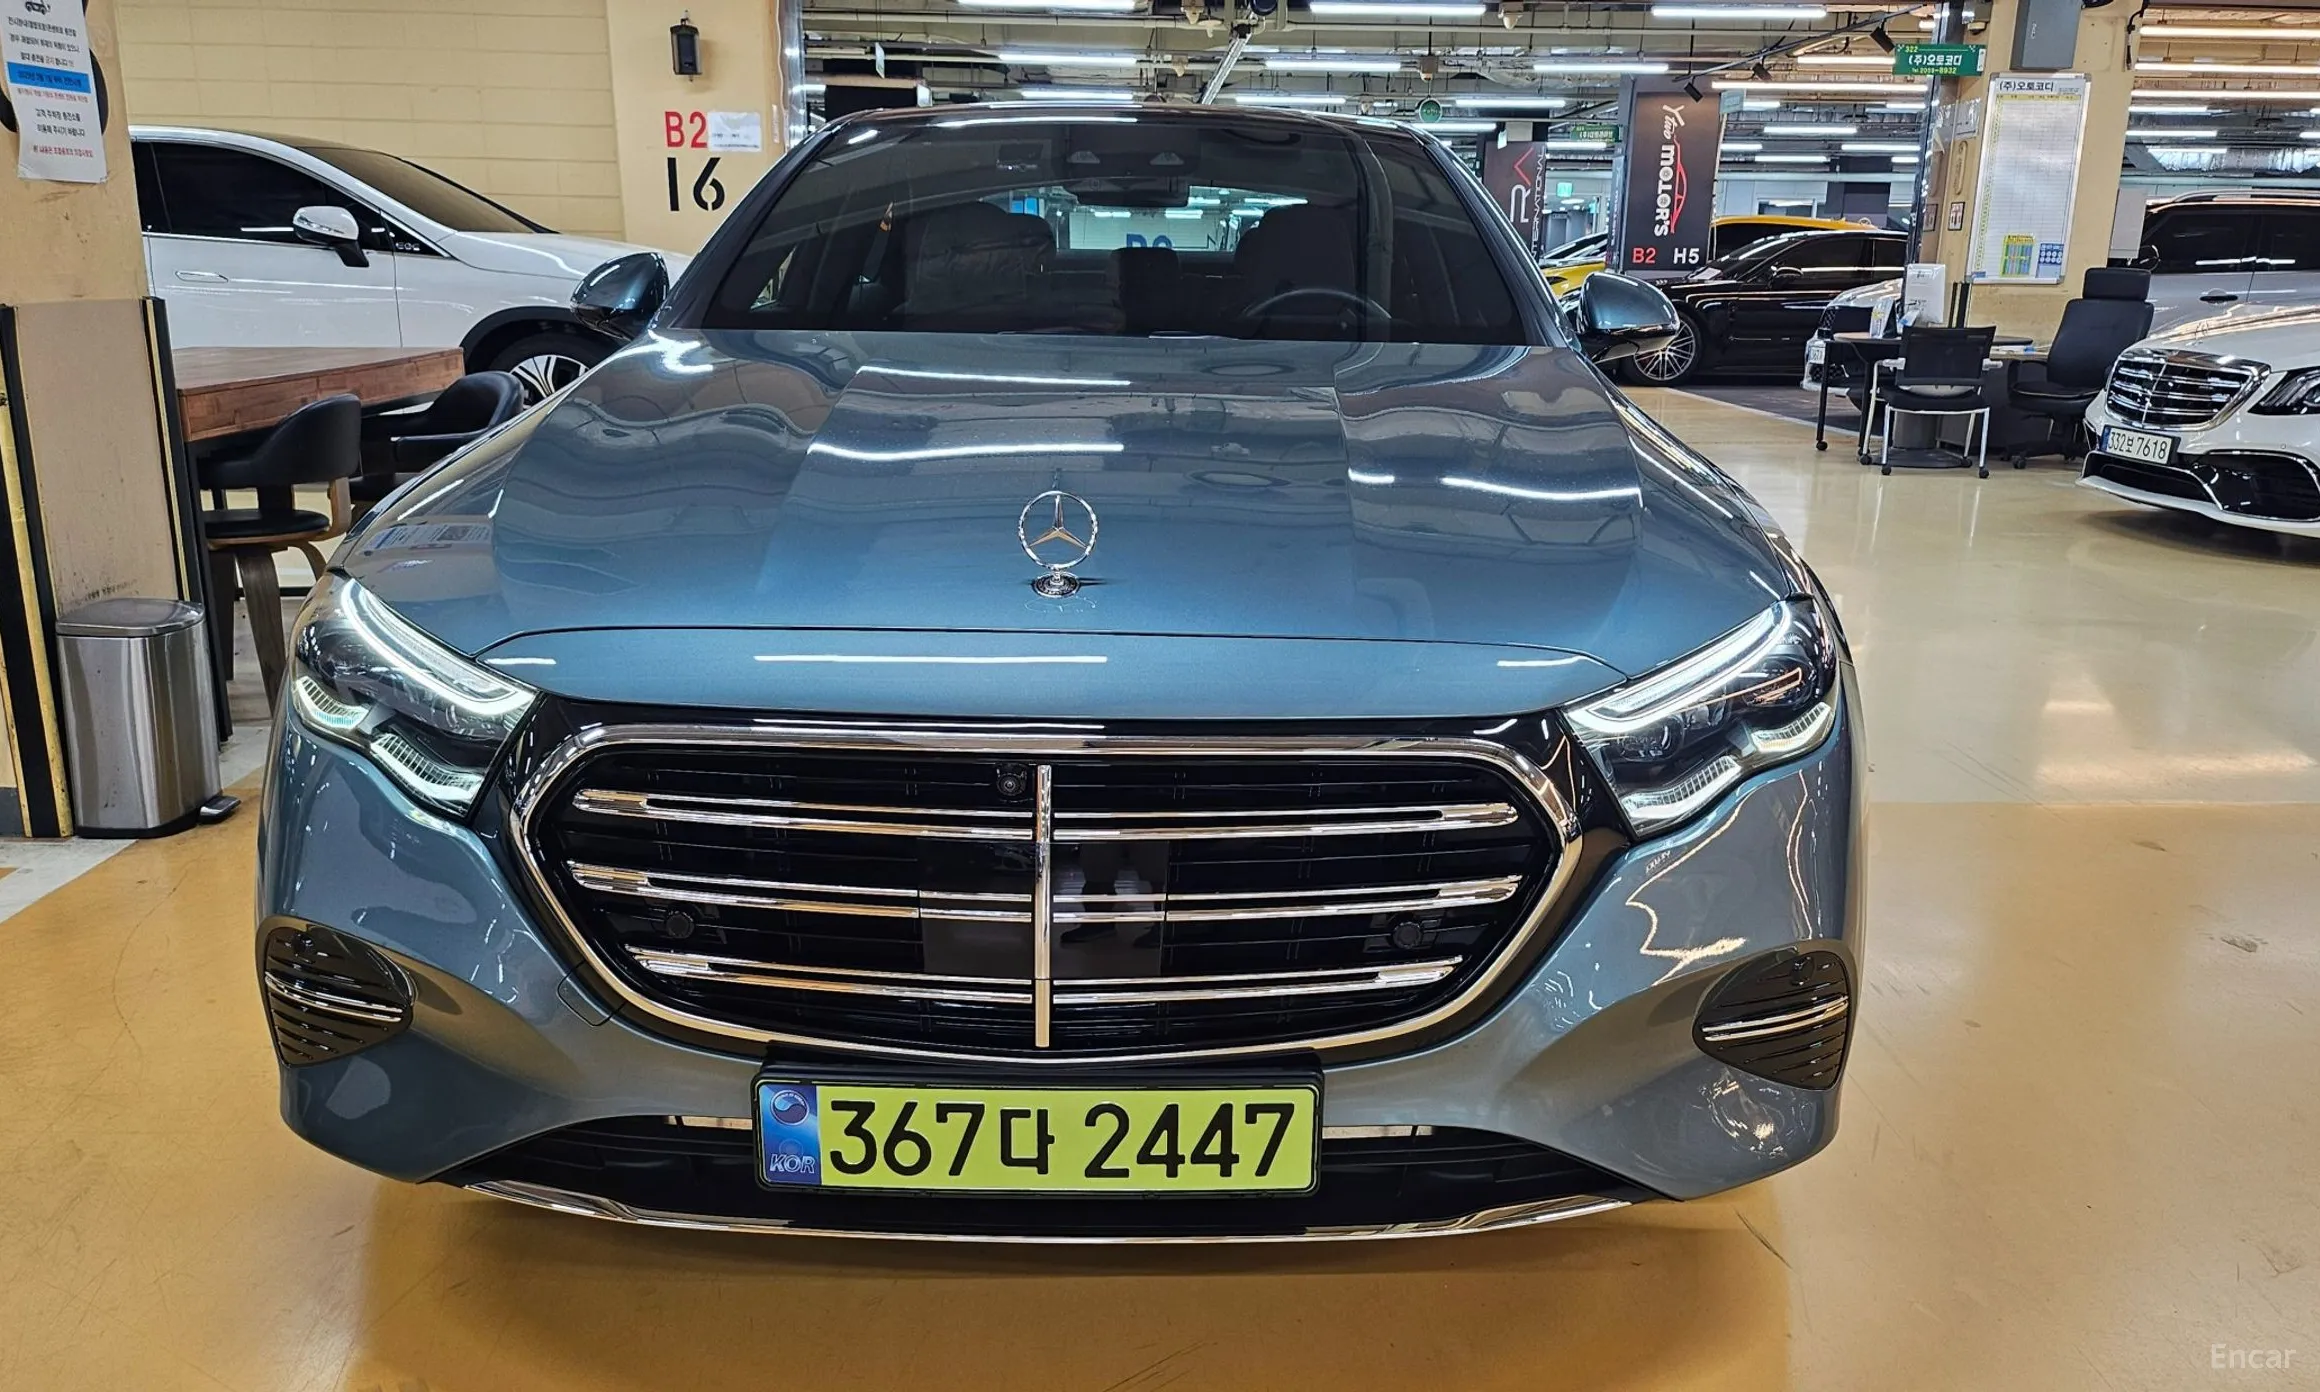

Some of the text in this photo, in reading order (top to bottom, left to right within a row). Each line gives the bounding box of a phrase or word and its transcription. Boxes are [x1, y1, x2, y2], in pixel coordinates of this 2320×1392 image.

[1908, 54, 1963, 66] (주)오토코디
[1999, 81, 2054, 92] (주)오토코디
[665, 111, 707, 148] B2
[667, 157, 725, 211] 16
[1632, 247, 1656, 264] B2
[1673, 247, 1700, 264] H5
[2136, 437, 2168, 460] 7618
[830, 1099, 1296, 1179] 367다 2447
[770, 1153, 816, 1174] KOR
